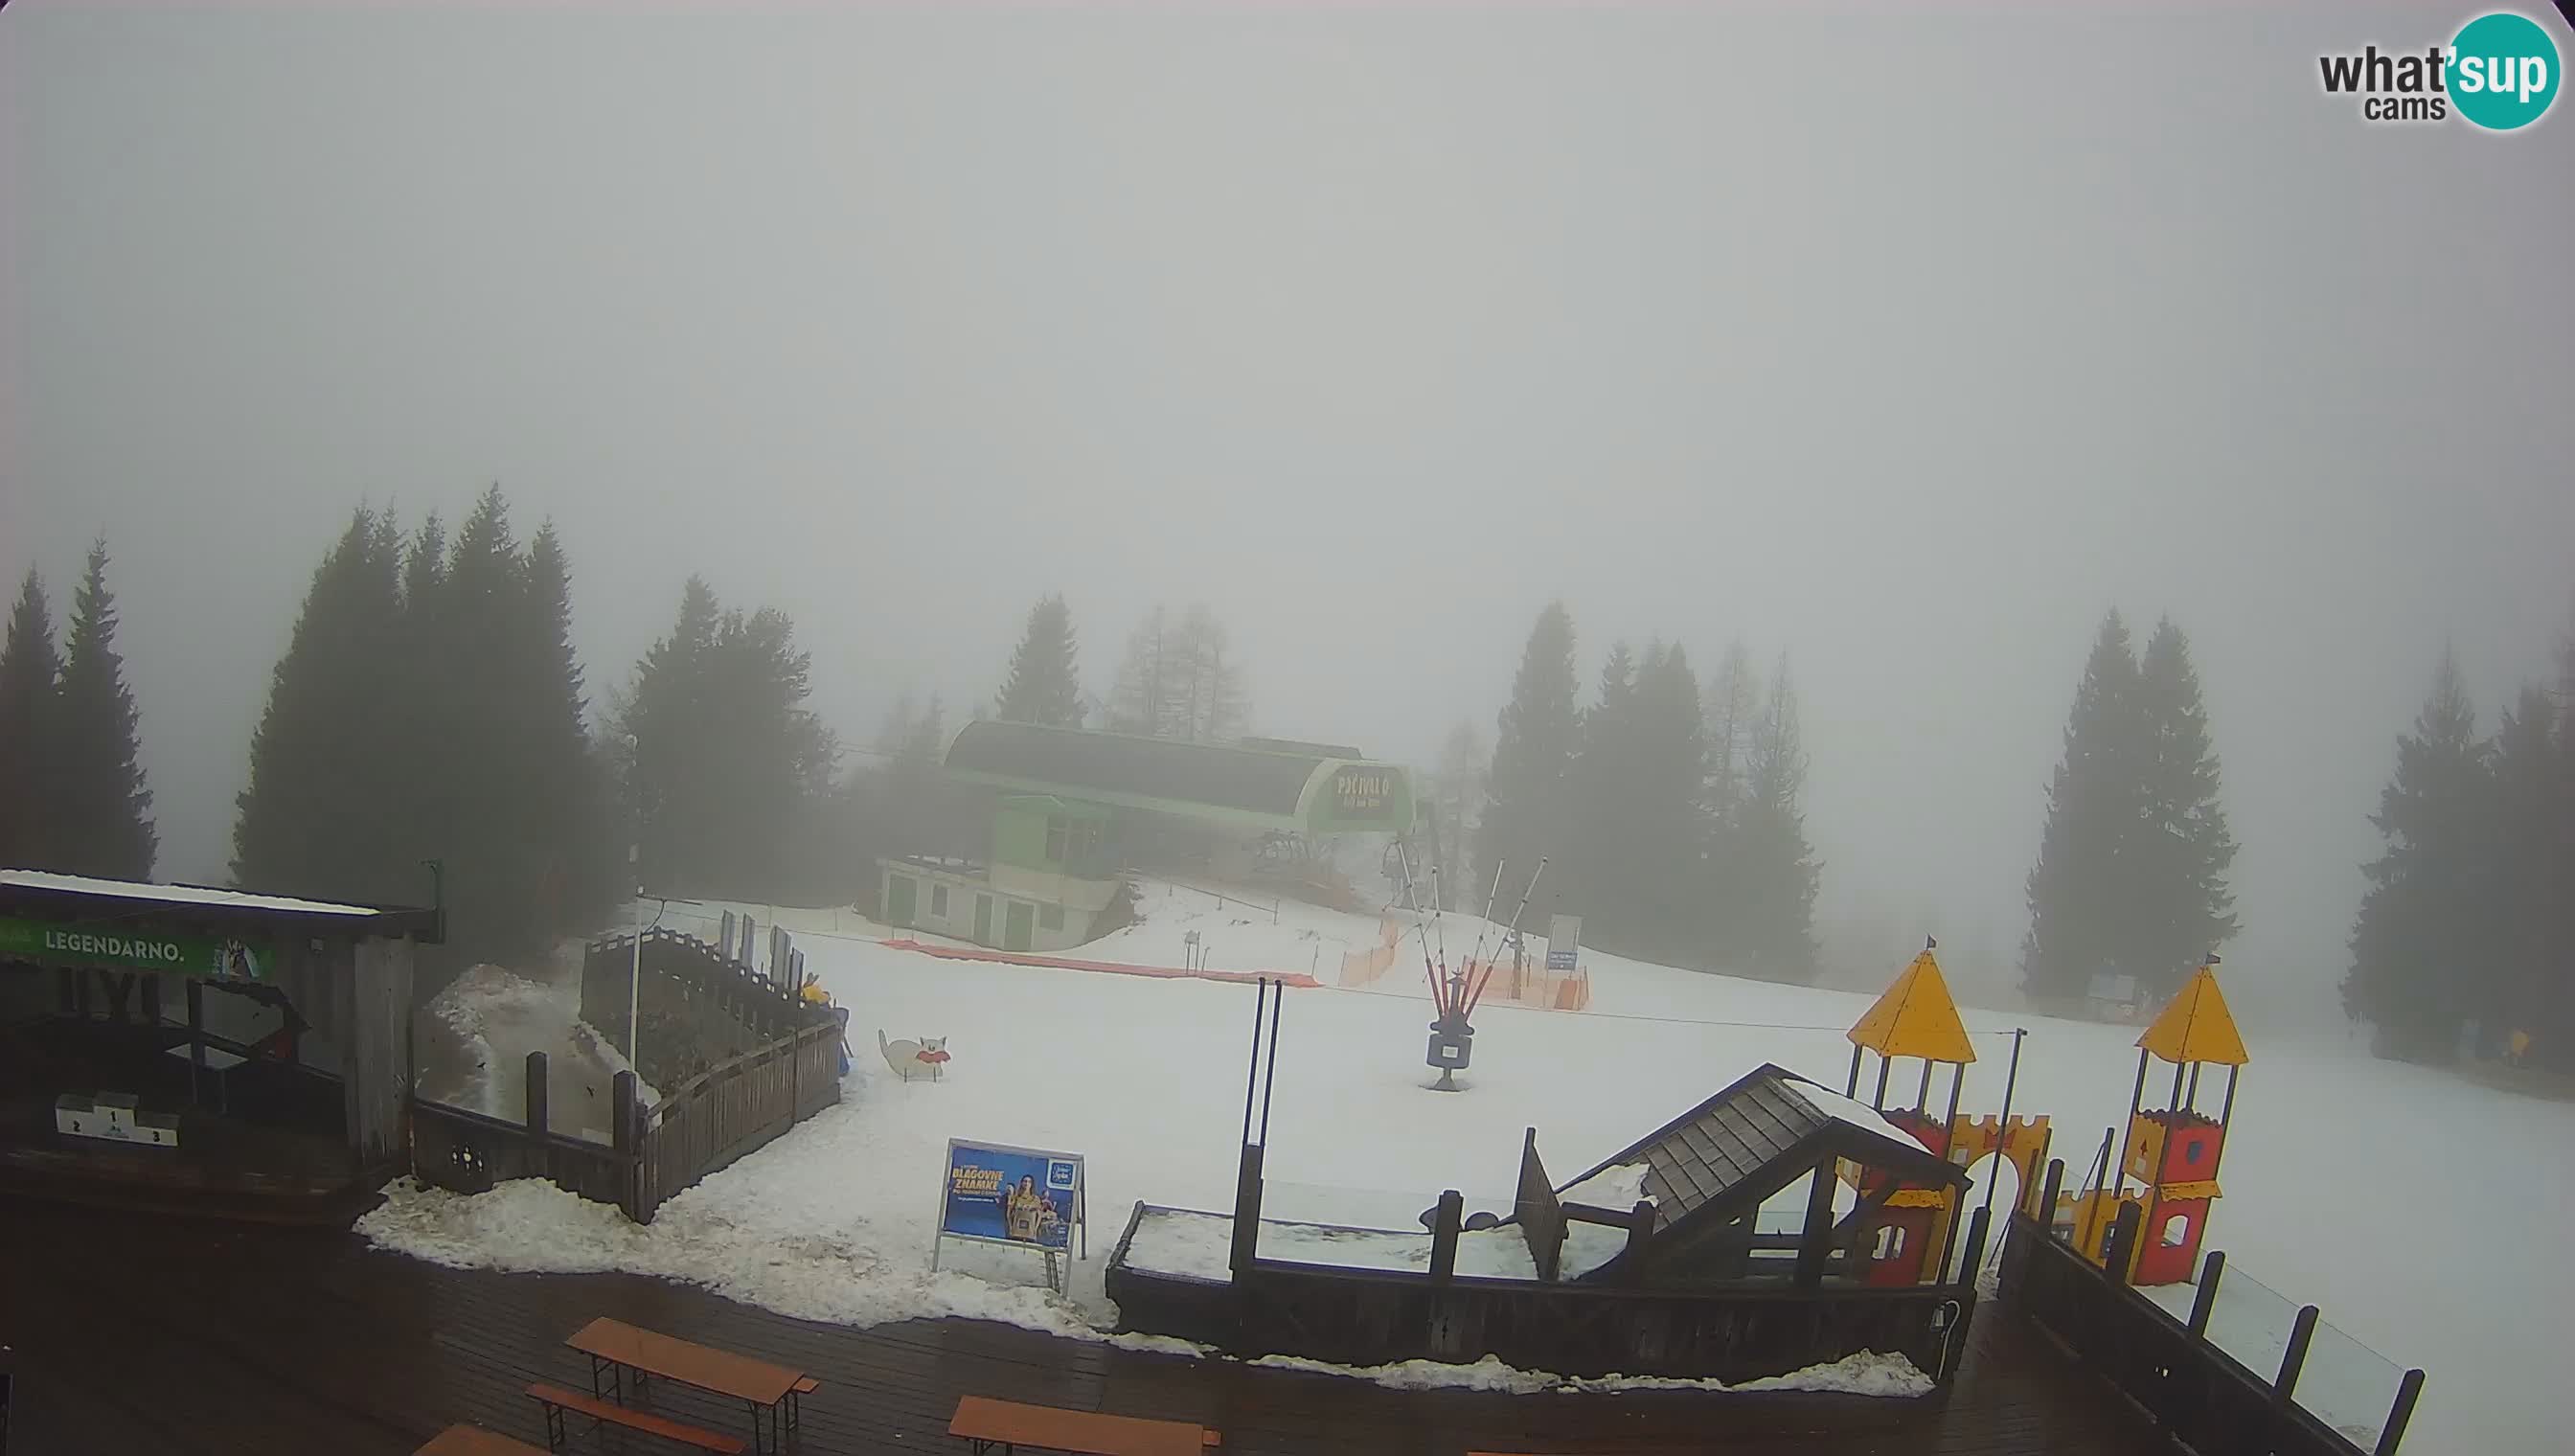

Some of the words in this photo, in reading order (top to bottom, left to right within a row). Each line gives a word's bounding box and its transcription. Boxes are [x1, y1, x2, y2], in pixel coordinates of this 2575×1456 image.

[45, 930, 185, 962] LEGENDARNO.
[110, 1110, 116, 1123] 1
[73, 1120, 80, 1132] 2
[152, 1130, 161, 1143] 3
[952, 1168, 1005, 1180] BLAGOVNE
[955, 1178, 998, 1191] ZNAMKE
